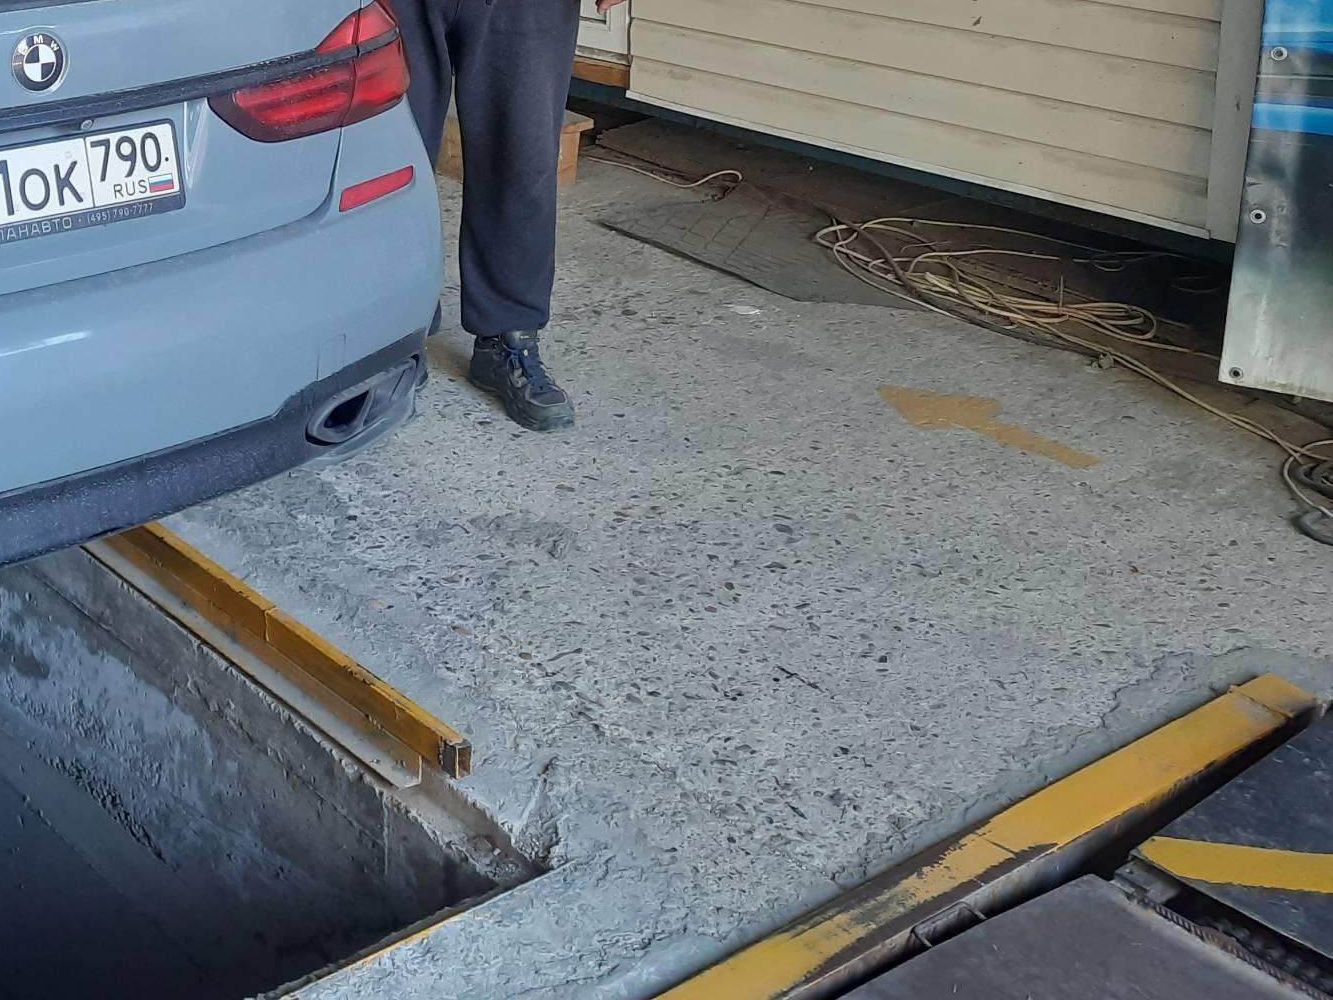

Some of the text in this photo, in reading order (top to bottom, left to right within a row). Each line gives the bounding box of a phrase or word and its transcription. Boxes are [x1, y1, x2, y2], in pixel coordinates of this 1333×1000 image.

[17, 34, 59, 56] BMW
[90, 131, 163, 182] 790
[113, 179, 148, 199] RUS
[87, 209, 111, 225] (495)
